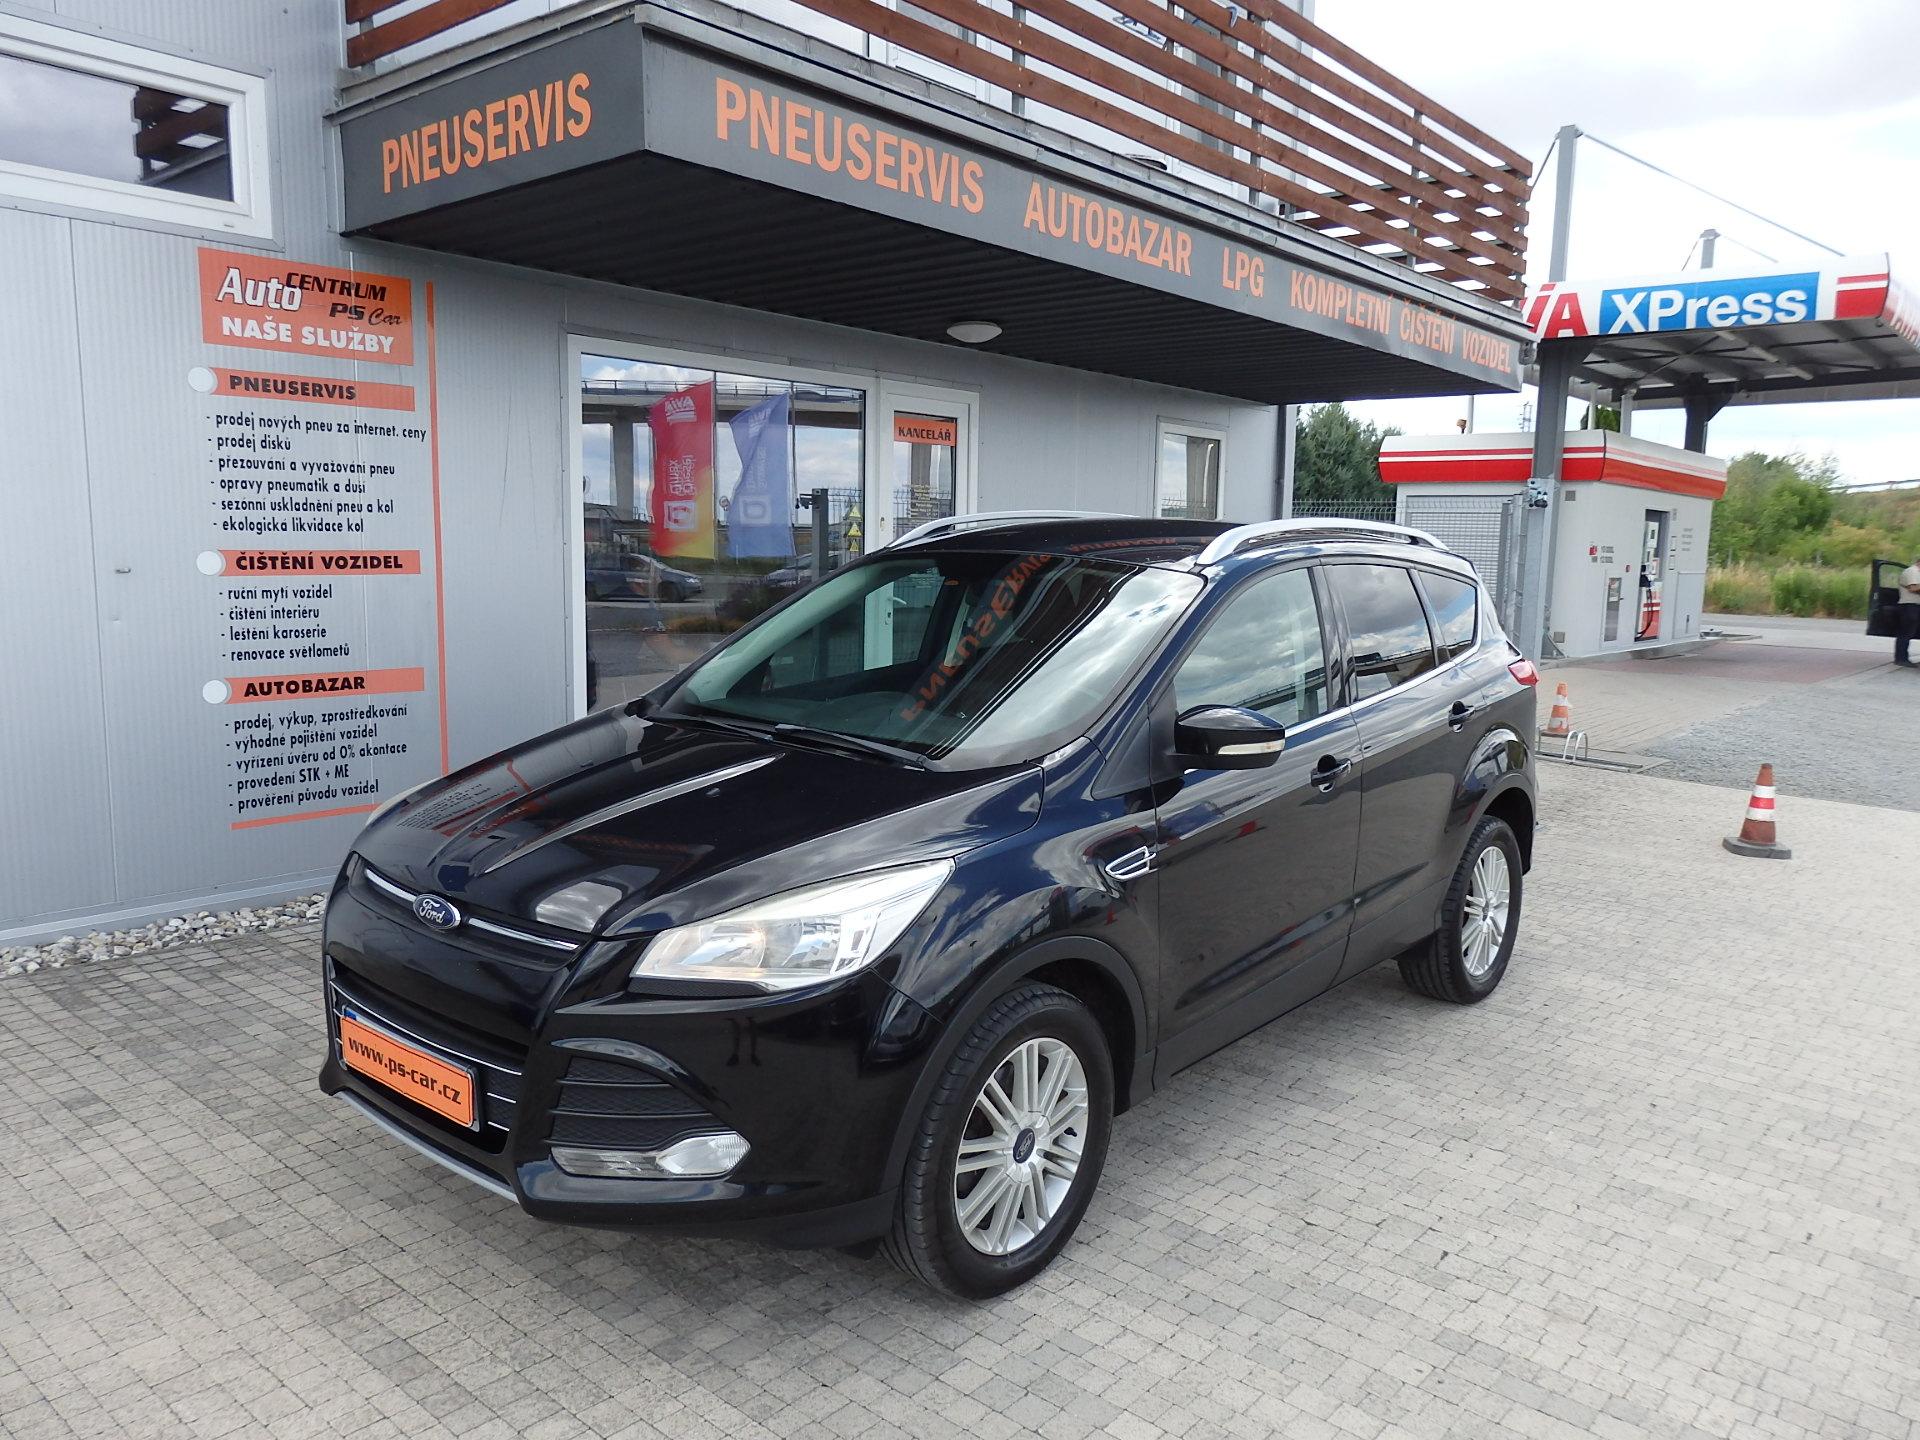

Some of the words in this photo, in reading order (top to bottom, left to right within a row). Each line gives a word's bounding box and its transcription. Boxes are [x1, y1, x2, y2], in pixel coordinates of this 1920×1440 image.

[382, 72, 592, 194] PNEUSERVIS
[715, 76, 984, 214] PNEUSERVIS
[1024, 185, 1192, 277] AUTOBAZAR
[1222, 247, 1265, 298] LPG
[1290, 269, 1394, 335] KOMPLETNÍ
[1400, 297, 1457, 354] ČIŠTĚNÍ
[1462, 328, 1512, 374] VOZIDEL
[215, 266, 303, 312] Auto
[286, 272, 387, 301] CENTRUM
[329, 302, 366, 321] PS
[368, 308, 404, 326] Car
[1607, 283, 1808, 333] XPress
[222, 315, 292, 343] NAŠE
[301, 326, 395, 354] SLUŽBY
[229, 375, 357, 400] PNEUSERVIS
[216, 411, 255, 430] prodej
[259, 415, 301, 433] nových
[305, 420, 333, 434] pneu
[337, 423, 350, 434] za
[354, 419, 399, 437] internet.
[402, 428, 427, 442] ceny
[898, 426, 951, 441] KANCELÁŘ
[217, 433, 256, 452] prodej
[260, 434, 291, 450] disků
[218, 455, 285, 472] přezouvání
[290, 461, 297, 471] a
[301, 460, 366, 476] vyvažování
[370, 464, 395, 478] pneu
[220, 479, 263, 494] opravy
[267, 477, 329, 494] pneumatik
[333, 483, 340, 493] a
[221, 497, 266, 511] sezónní
[270, 496, 332, 512] uskladnění
[336, 502, 363, 516] pneu
[366, 503, 373, 513] a
[377, 498, 394, 513] kol
[222, 515, 287, 535] ekologická
[292, 516, 343, 532] likvidace
[347, 517, 364, 533] kol
[235, 551, 314, 570] ČIŠTĚNÍ
[320, 555, 403, 570] VOZIDEL
[228, 586, 257, 600] ruční
[292, 583, 333, 599] vozidel
[229, 605, 267, 620] čištění
[270, 604, 320, 619] interiéru
[230, 625, 269, 640] leštění
[273, 623, 327, 639] karoserie
[231, 649, 285, 661] renovace
[289, 642, 350, 658] světlometů
[244, 676, 366, 698] AUTOBAZAR
[234, 713, 274, 734] prodej,
[279, 710, 317, 729] výkup,
[321, 704, 407, 725] zprostředkování
[235, 732, 285, 753] výhodné
[290, 728, 336, 748] pojištění
[340, 723, 377, 739] vozidel
[236, 753, 284, 773] vyřízení
[287, 751, 319, 764] úvěru
[323, 746, 336, 761] od
[340, 744, 355, 759] 0%
[359, 743, 407, 757] akontace
[237, 771, 295, 794] provedení
[299, 767, 321, 783] STK
[334, 764, 349, 778] ME
[238, 790, 294, 814] prověření
[298, 785, 337, 805] původu
[341, 779, 379, 796] vozidel
[419, 898, 444, 924] Ford
[348, 1037, 462, 1105] www.ps-car.cz
